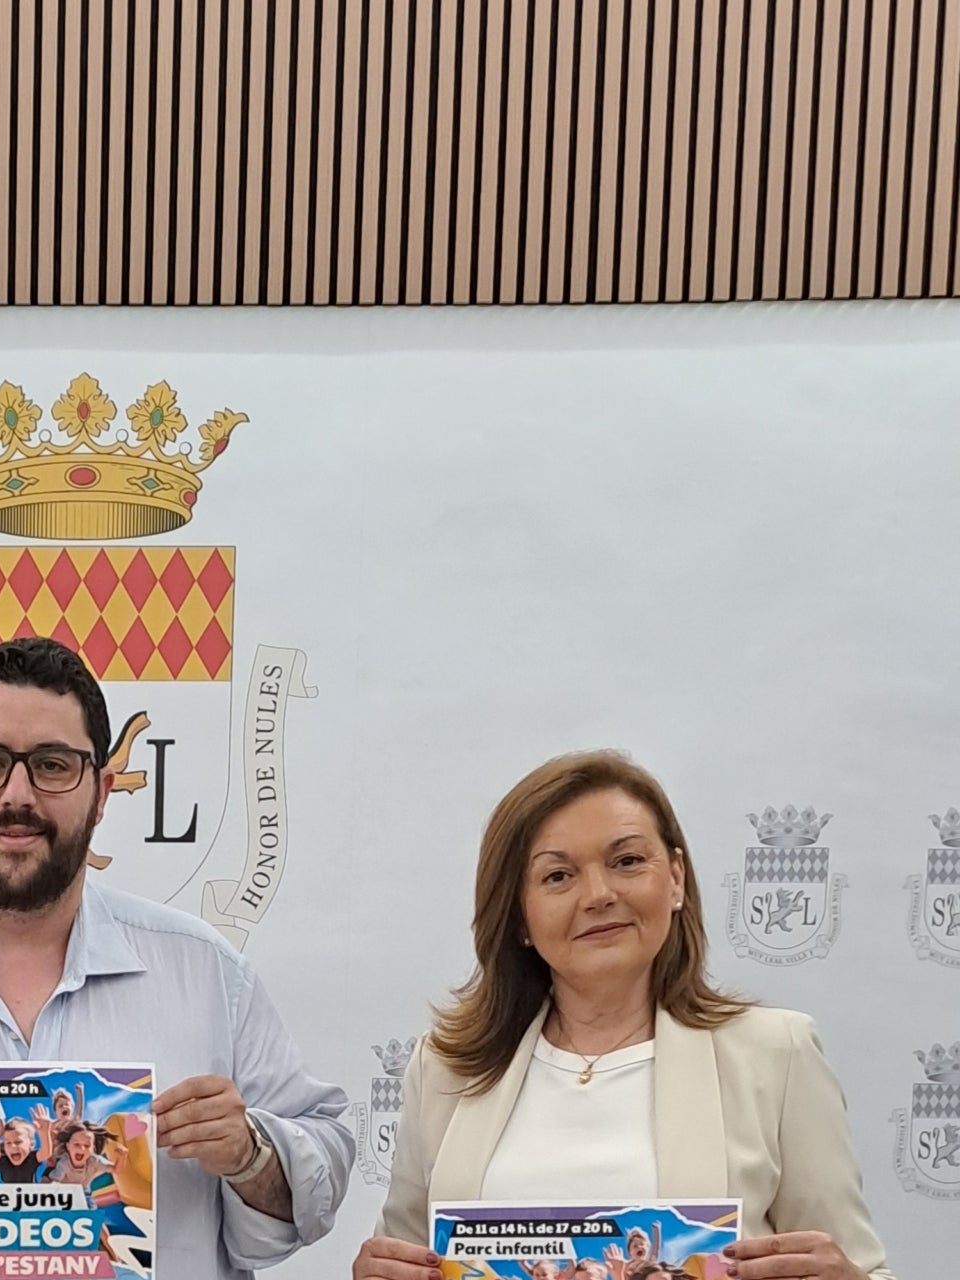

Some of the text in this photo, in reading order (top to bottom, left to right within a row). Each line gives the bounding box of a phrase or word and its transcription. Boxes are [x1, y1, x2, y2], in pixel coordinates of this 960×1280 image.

[144, 739, 198, 843] L
[241, 664, 283, 910] HONOR DE NULES
[0, 1086, 9, 1094] a
[11, 1083, 27, 1094] 20
[29, 1083, 39, 1094] h
[13, 1187, 73, 1211] juny
[456, 1224, 473, 1235] De
[475, 1224, 487, 1234] 11
[490, 1226, 499, 1234] a
[500, 1223, 515, 1234] 14
[517, 1223, 527, 1234] h
[536, 1223, 554, 1234] de
[556, 1223, 569, 1234] 17
[571, 1225, 581, 1233] a
[583, 1223, 600, 1234] 20
[603, 1223, 613, 1233] h
[454, 1241, 565, 1255] Parc infantil
